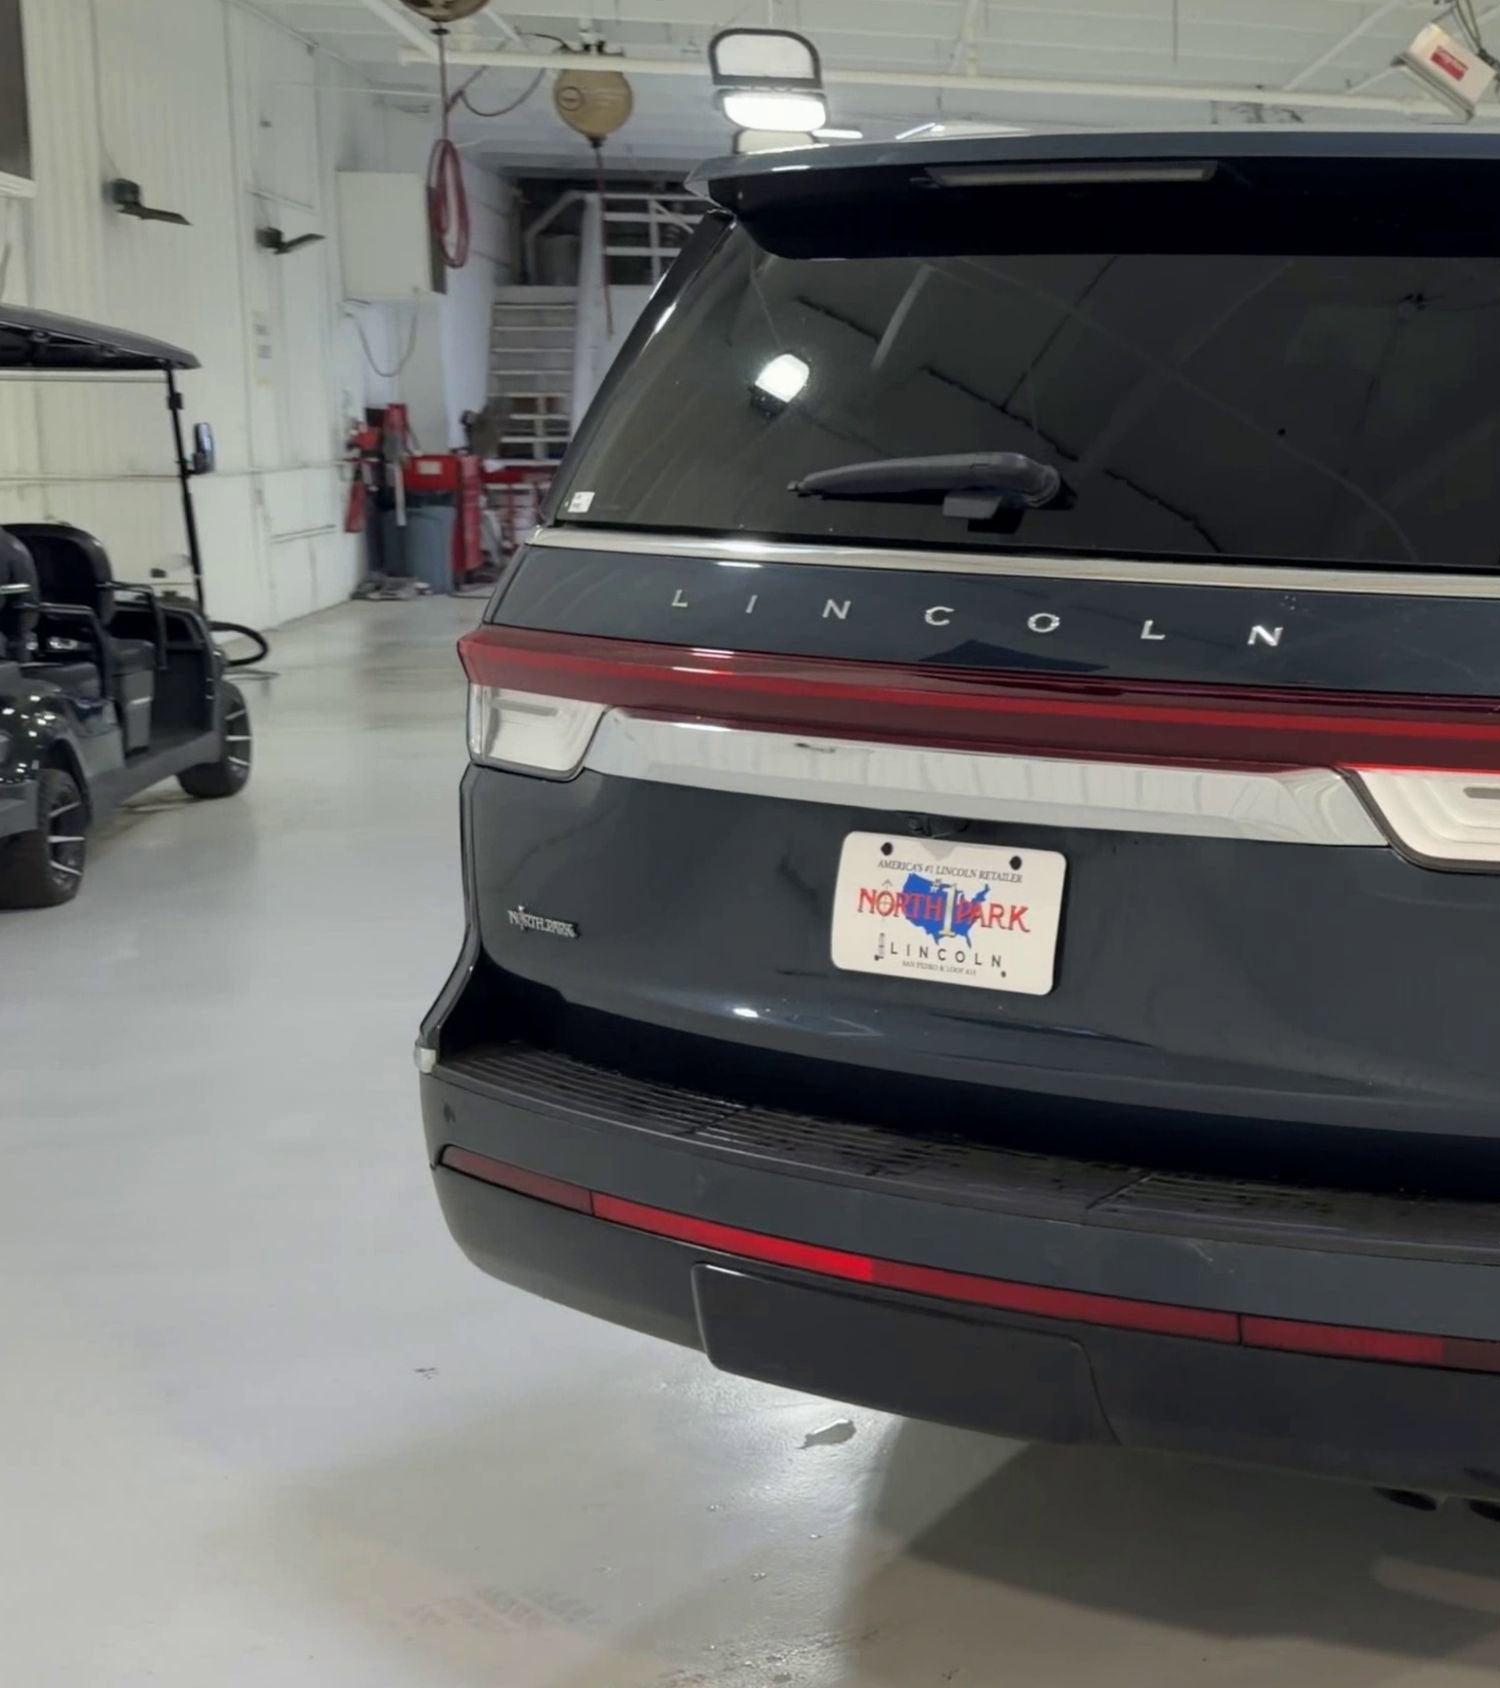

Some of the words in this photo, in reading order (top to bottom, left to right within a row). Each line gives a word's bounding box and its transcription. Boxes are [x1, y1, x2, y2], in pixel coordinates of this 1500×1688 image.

[672, 589, 1283, 647] LINCOLN
[878, 860, 923, 872] AMERICA'S
[936, 865, 976, 878] LINCOLN
[978, 870, 1022, 883] RETAILER
[857, 888, 943, 921] NORTH
[956, 898, 1031, 933] PARK
[890, 941, 1002, 968] LINCOLN
